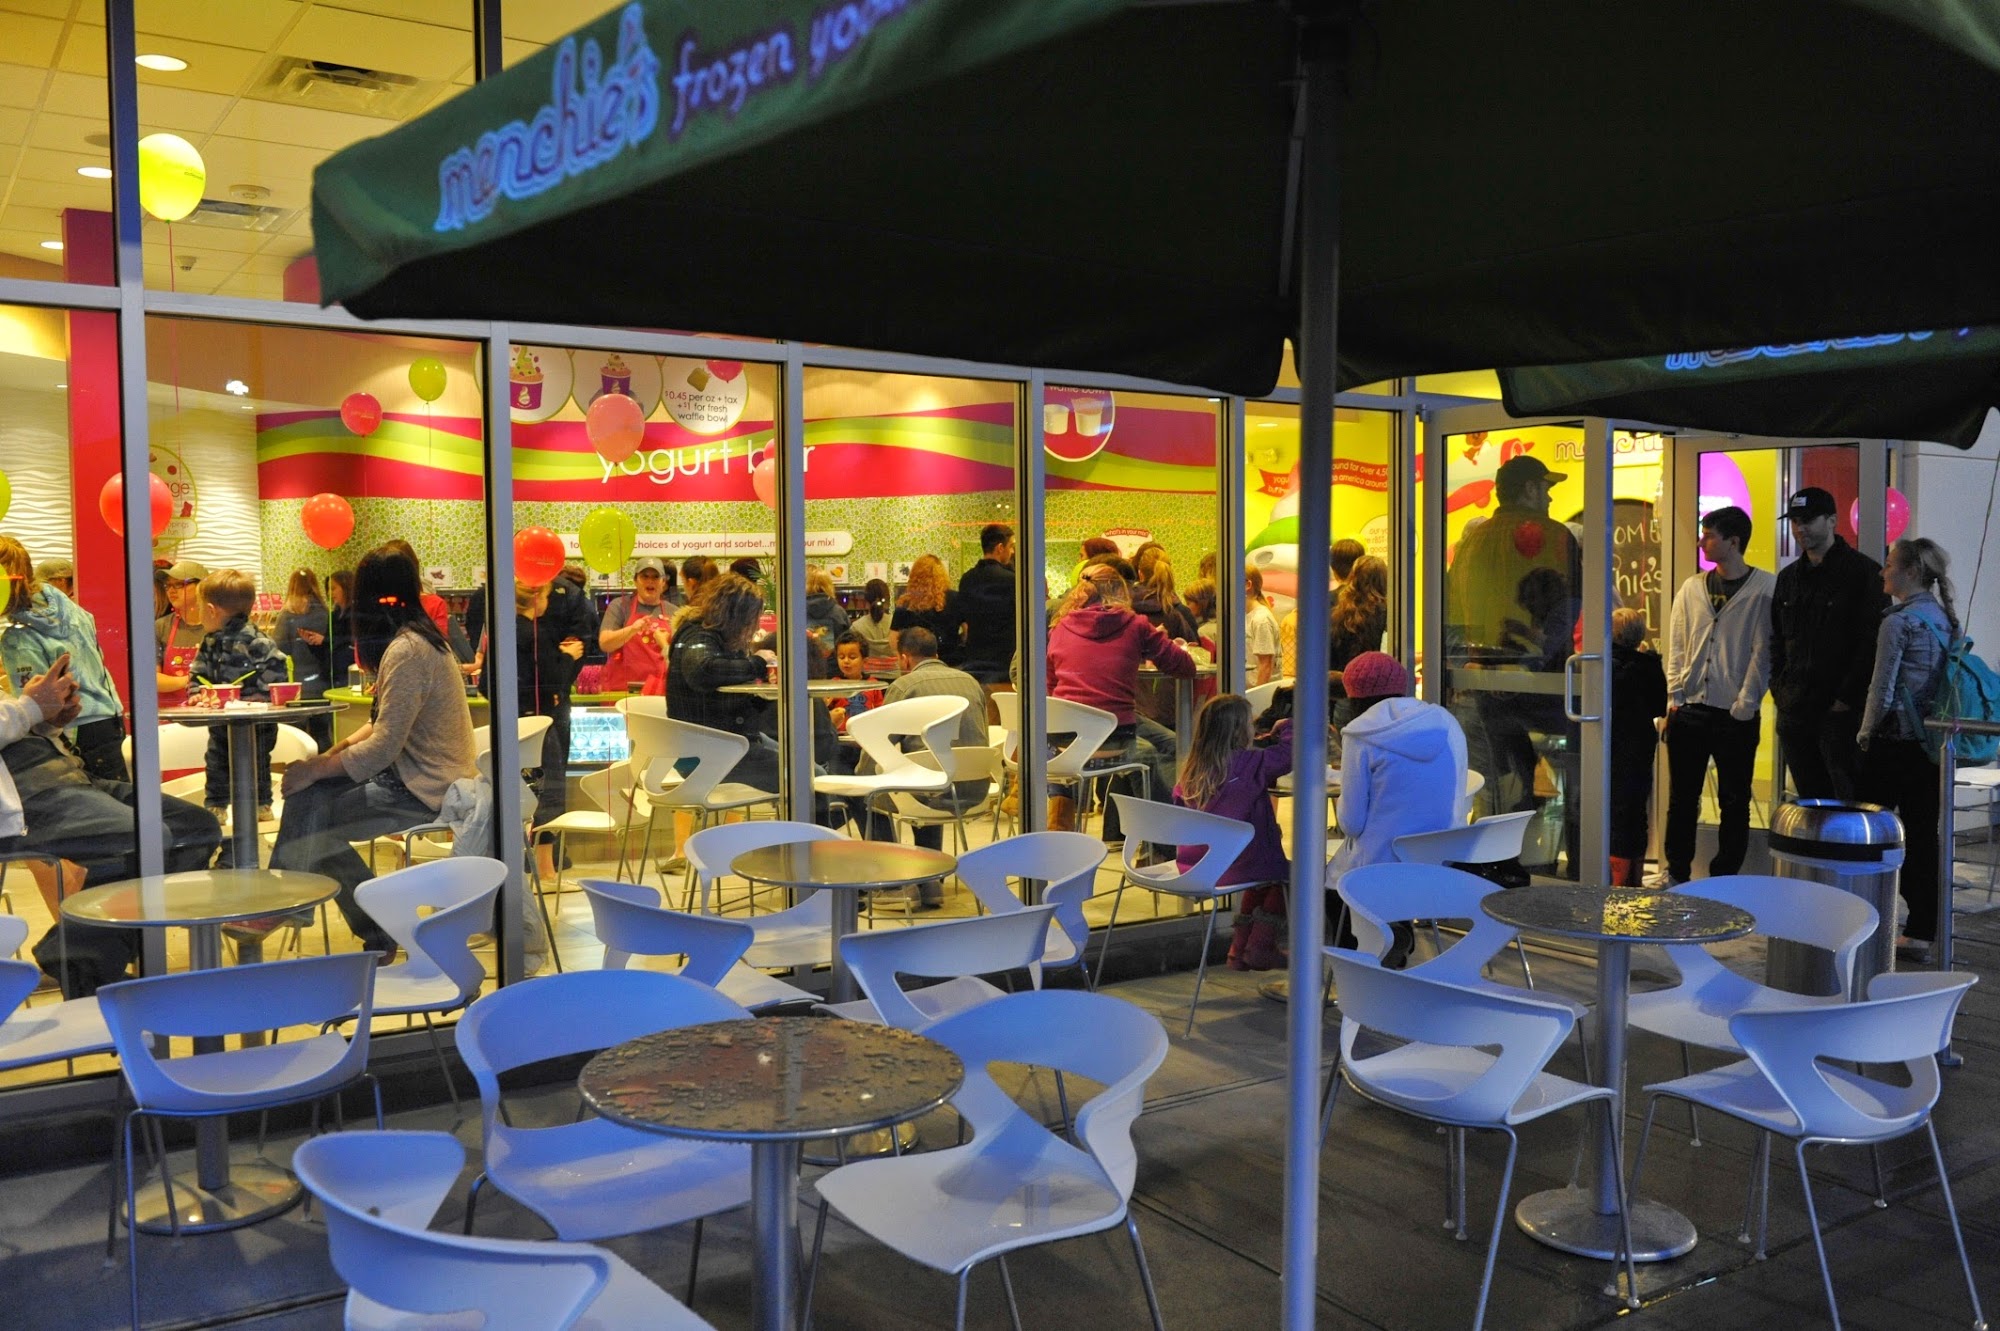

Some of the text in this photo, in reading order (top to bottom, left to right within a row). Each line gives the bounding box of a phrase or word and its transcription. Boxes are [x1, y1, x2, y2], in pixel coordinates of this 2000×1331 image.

[433, 0, 660, 231] menchie's
[670, 31, 794, 134] frozen
[665, 390, 687, 400] $0.45
[688, 393, 703, 402] per
[724, 395, 738, 404] tax
[683, 402, 691, 411] $1
[694, 403, 705, 412] for
[707, 404, 728, 413] fresh
[677, 412, 728, 423] waffle bowl
[596, 439, 816, 485] yogurt br
[670, 540, 680, 549] of
[682, 540, 712, 551] yogurt
[714, 539, 732, 549] and
[817, 538, 836, 547] mix!
